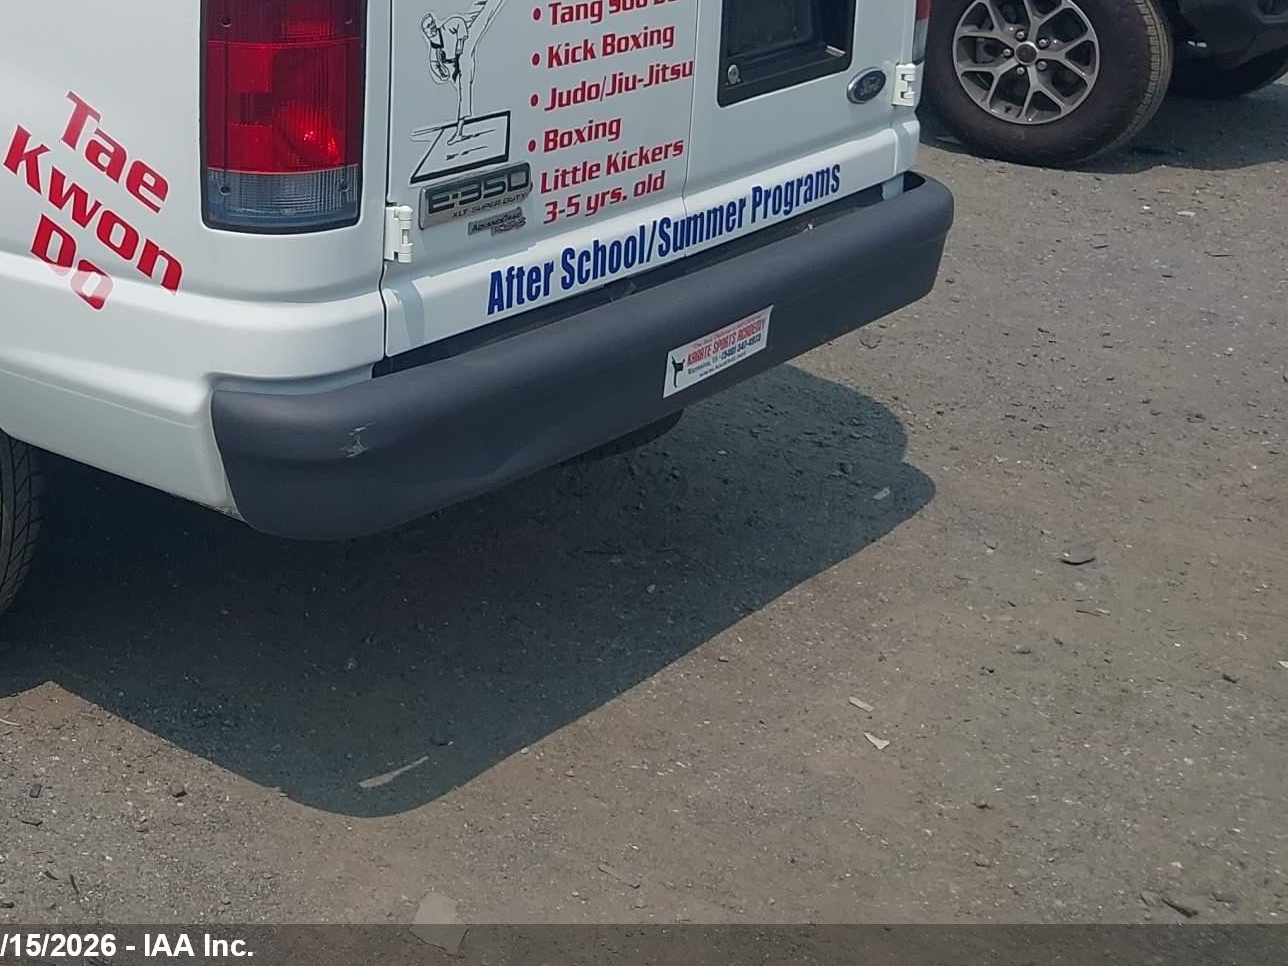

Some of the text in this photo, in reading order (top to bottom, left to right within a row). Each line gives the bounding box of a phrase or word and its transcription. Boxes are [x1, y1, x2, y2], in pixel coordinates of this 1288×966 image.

[548, 0, 603, 26] Tang
[547, 25, 675, 69] Kick Boxing
[544, 60, 694, 111] Judo/Jiu-Jitsu
[61, 90, 169, 214] Tae
[543, 118, 621, 153] Boxing
[540, 139, 684, 194] Little Kickers
[3, 124, 183, 296] Kwon
[471, 200, 501, 213] SUPER
[502, 194, 526, 205] DUTY
[543, 170, 665, 224] 3-5 yrs. old
[30, 213, 113, 310] Do
[487, 164, 842, 316] After School/Summer Programs
[687, 344, 712, 366] KARATE
[712, 332, 737, 354] SPORTS
